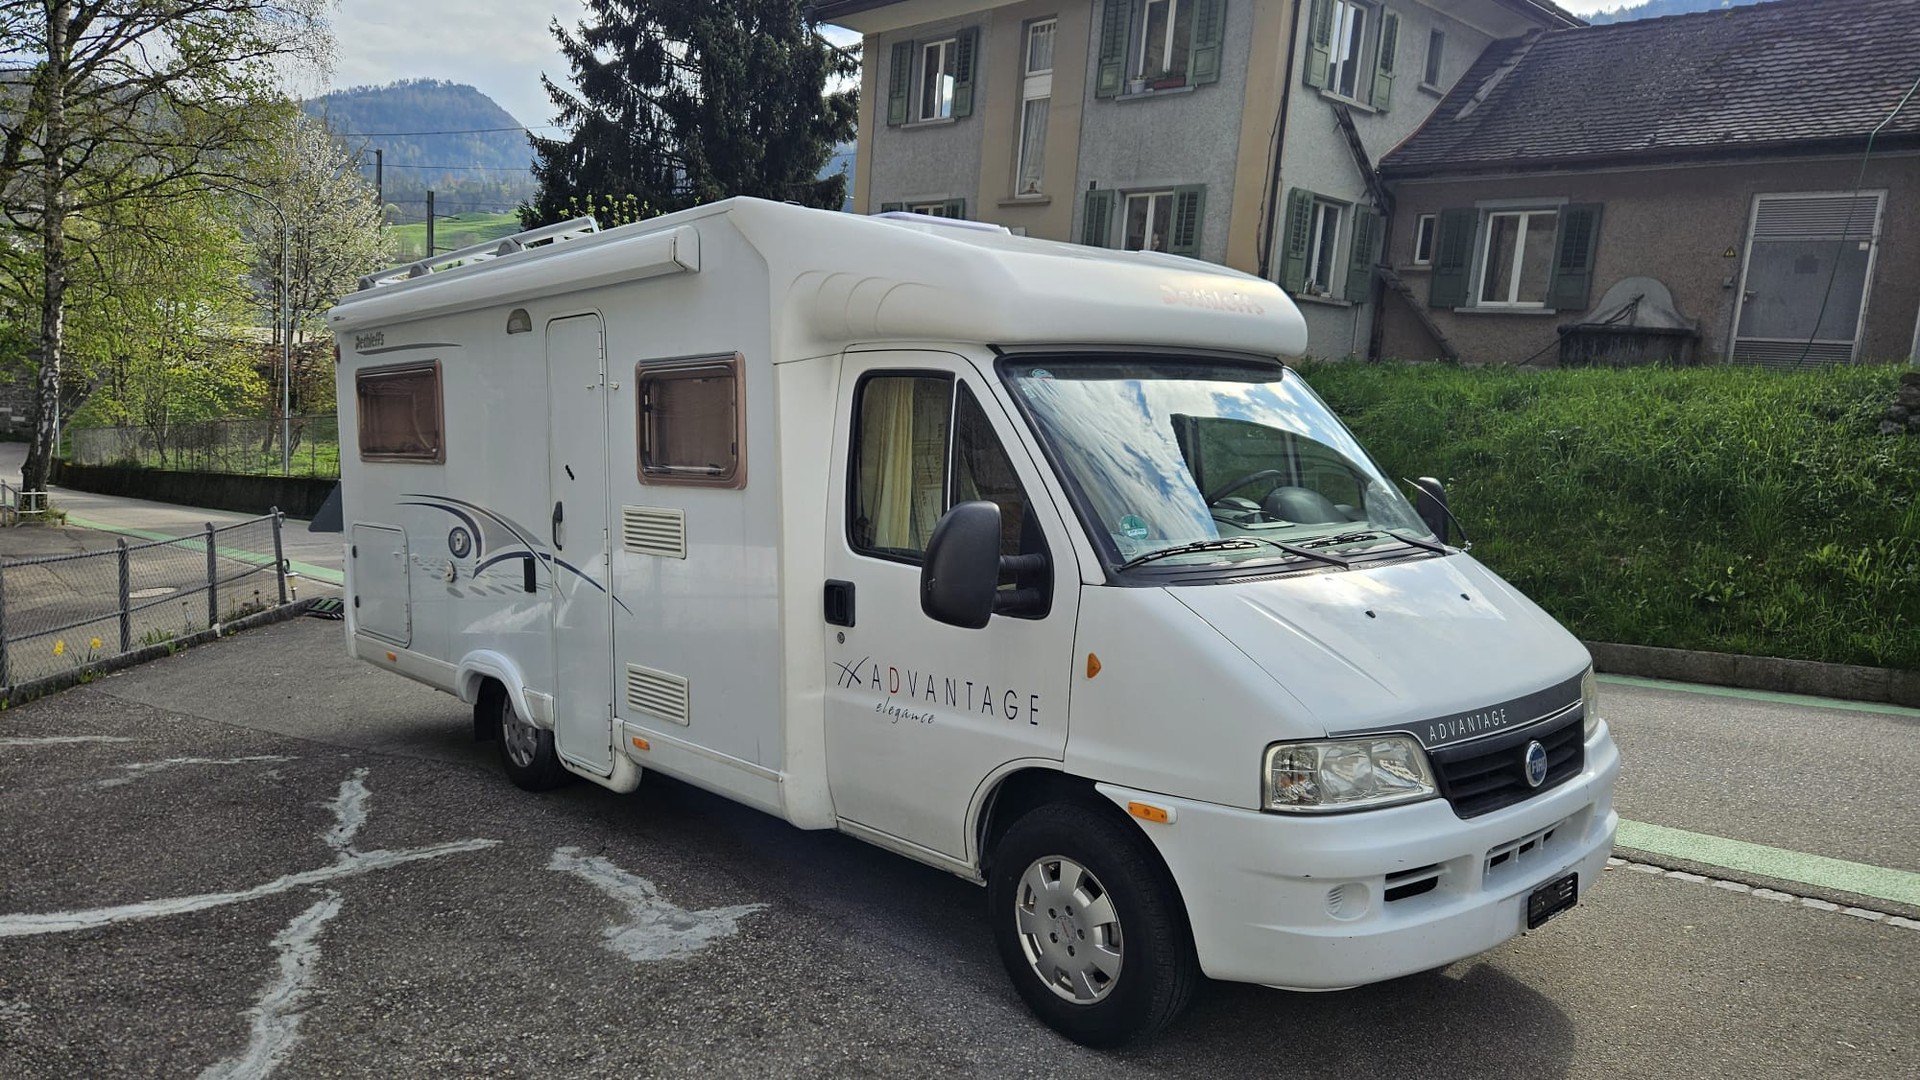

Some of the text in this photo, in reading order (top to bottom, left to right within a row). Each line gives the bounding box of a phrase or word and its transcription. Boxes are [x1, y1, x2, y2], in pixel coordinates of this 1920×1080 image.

[871, 663, 1039, 726] ADVANTAGE
[875, 696, 935, 724] elegance
[1429, 708, 1508, 741] ADVANTAGE
